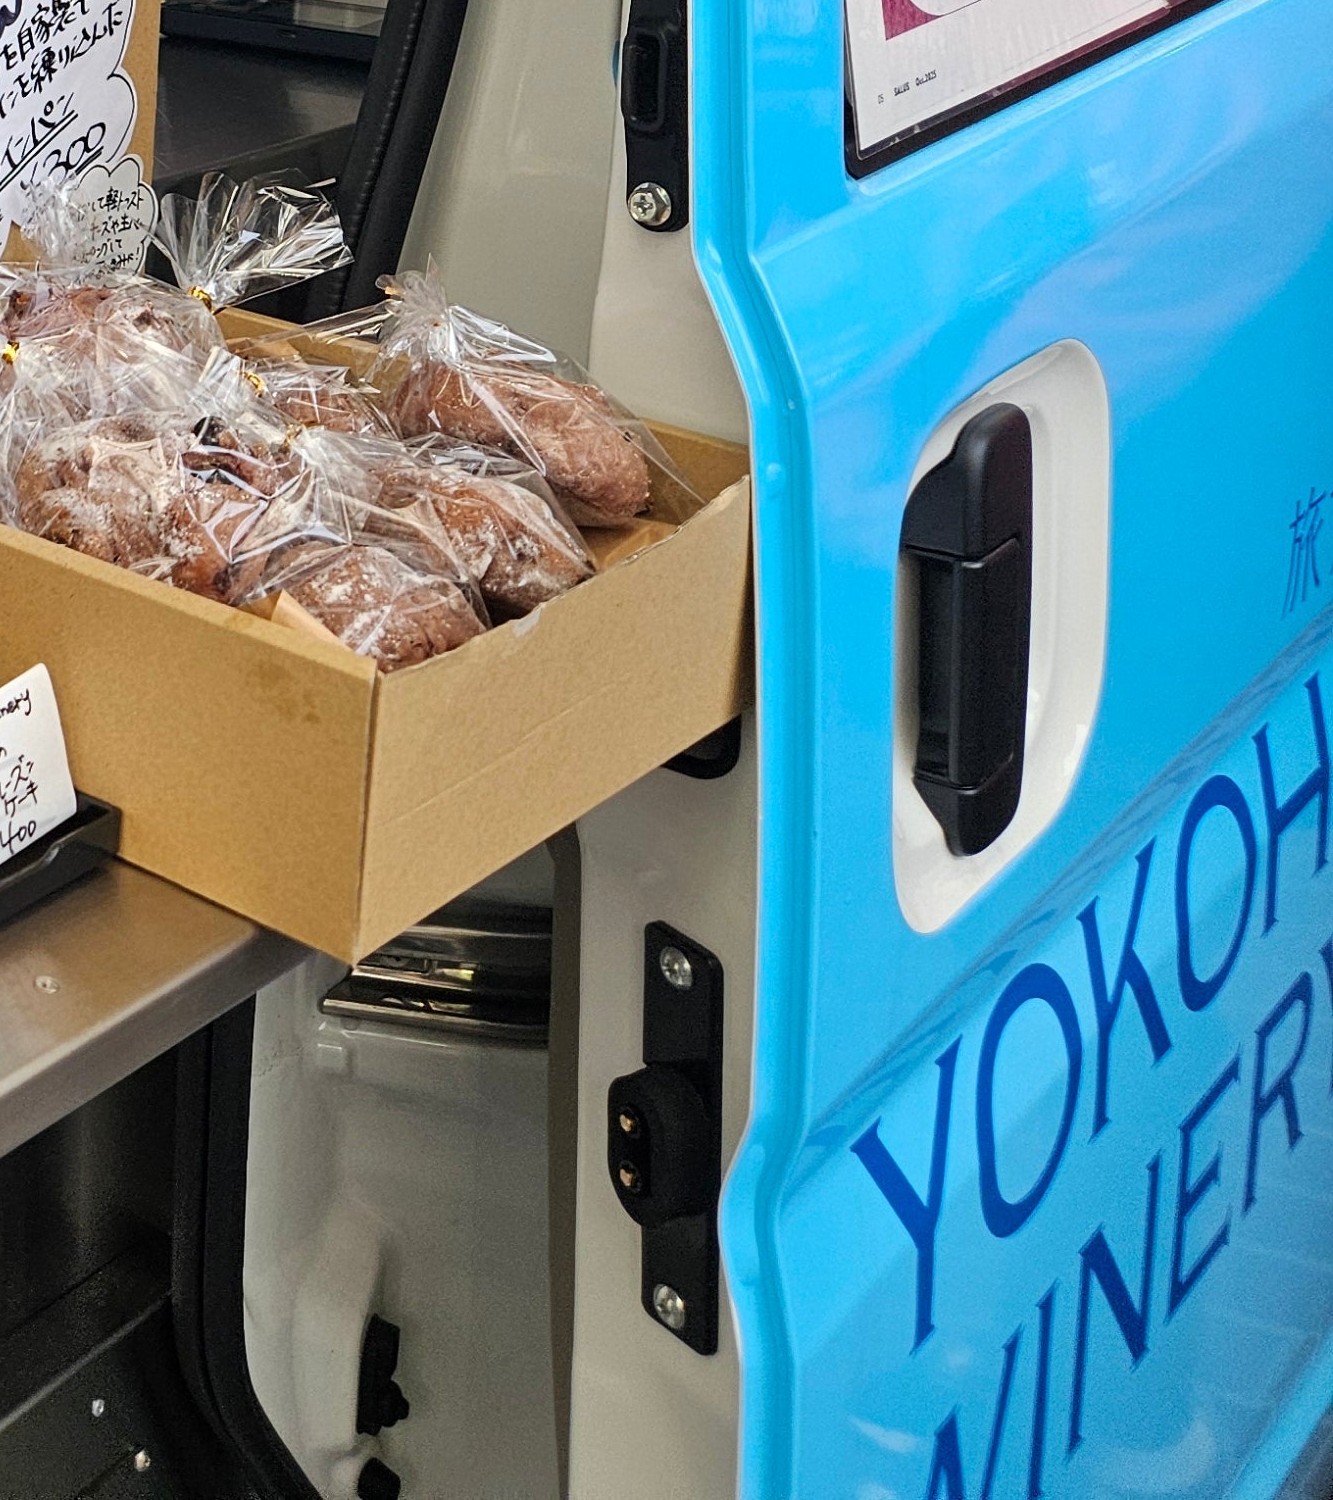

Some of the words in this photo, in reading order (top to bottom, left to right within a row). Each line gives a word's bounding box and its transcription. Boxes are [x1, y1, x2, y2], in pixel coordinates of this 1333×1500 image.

[4, 781, 39, 818] ケーキ
[850, 668, 1333, 1356] YOKOH
